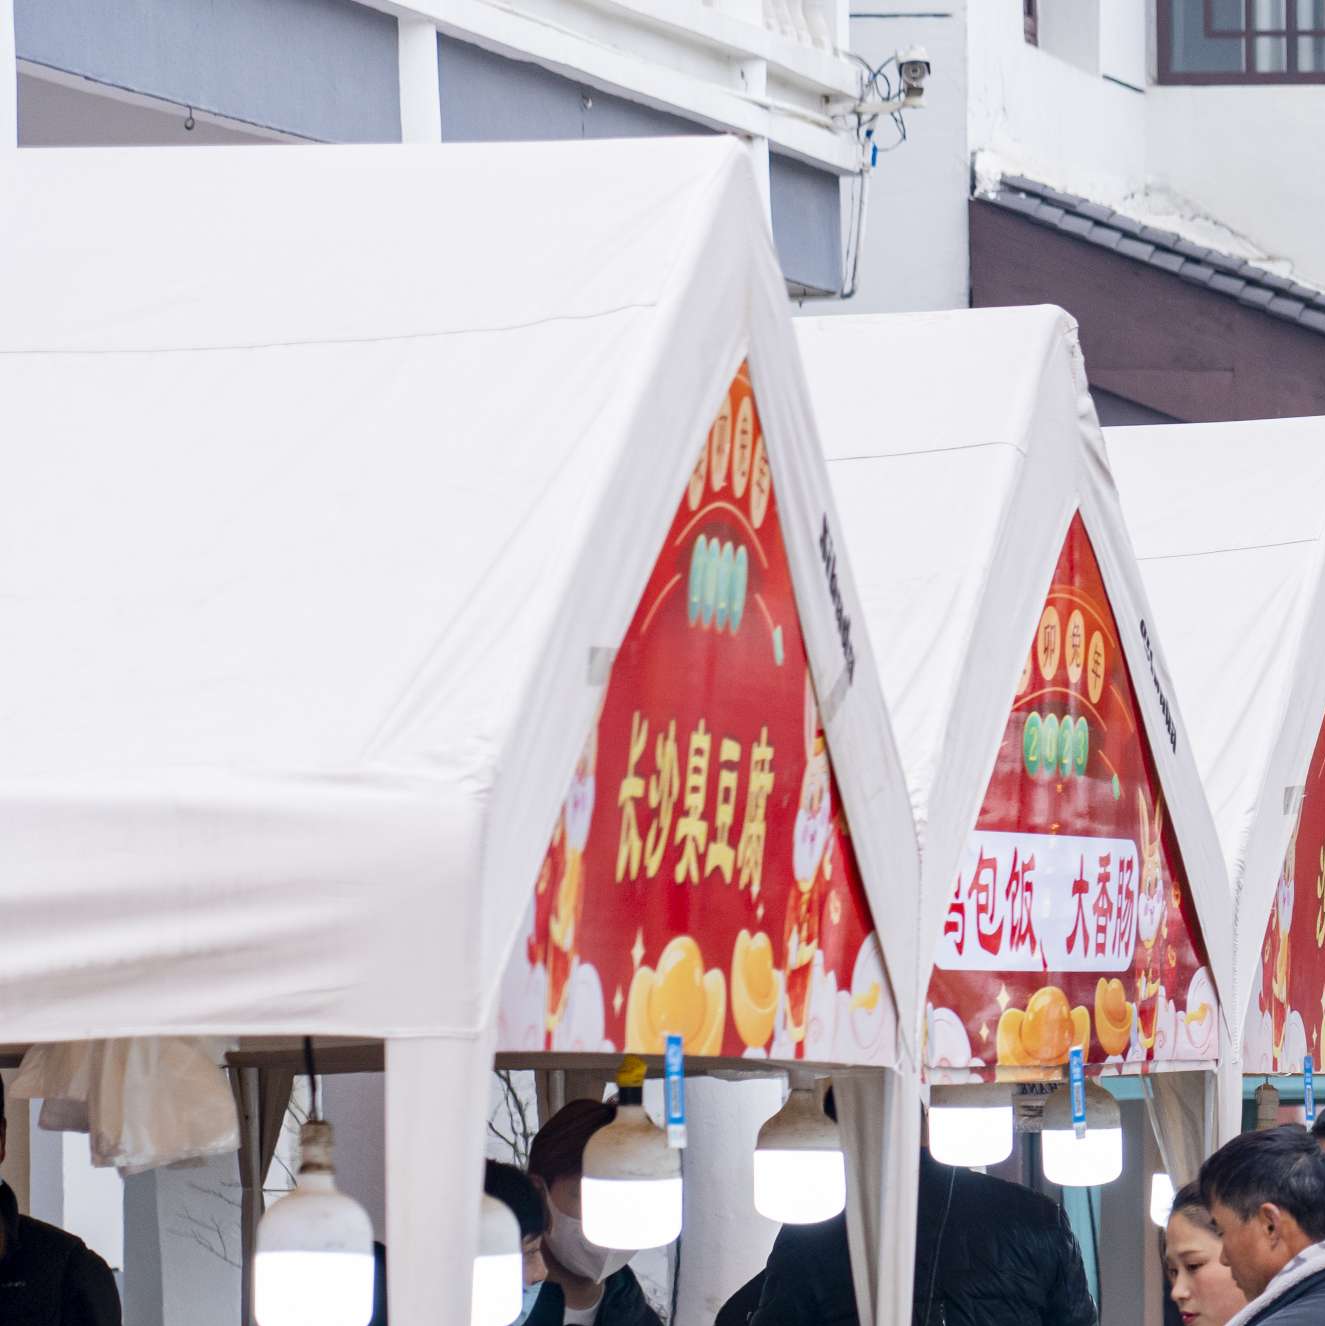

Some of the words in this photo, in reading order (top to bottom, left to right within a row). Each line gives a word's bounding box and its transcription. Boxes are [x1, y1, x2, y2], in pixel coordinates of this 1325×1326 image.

[615, 710, 776, 897] 长沙臭豆腐
[1065, 851, 1134, 958] 大香肠
